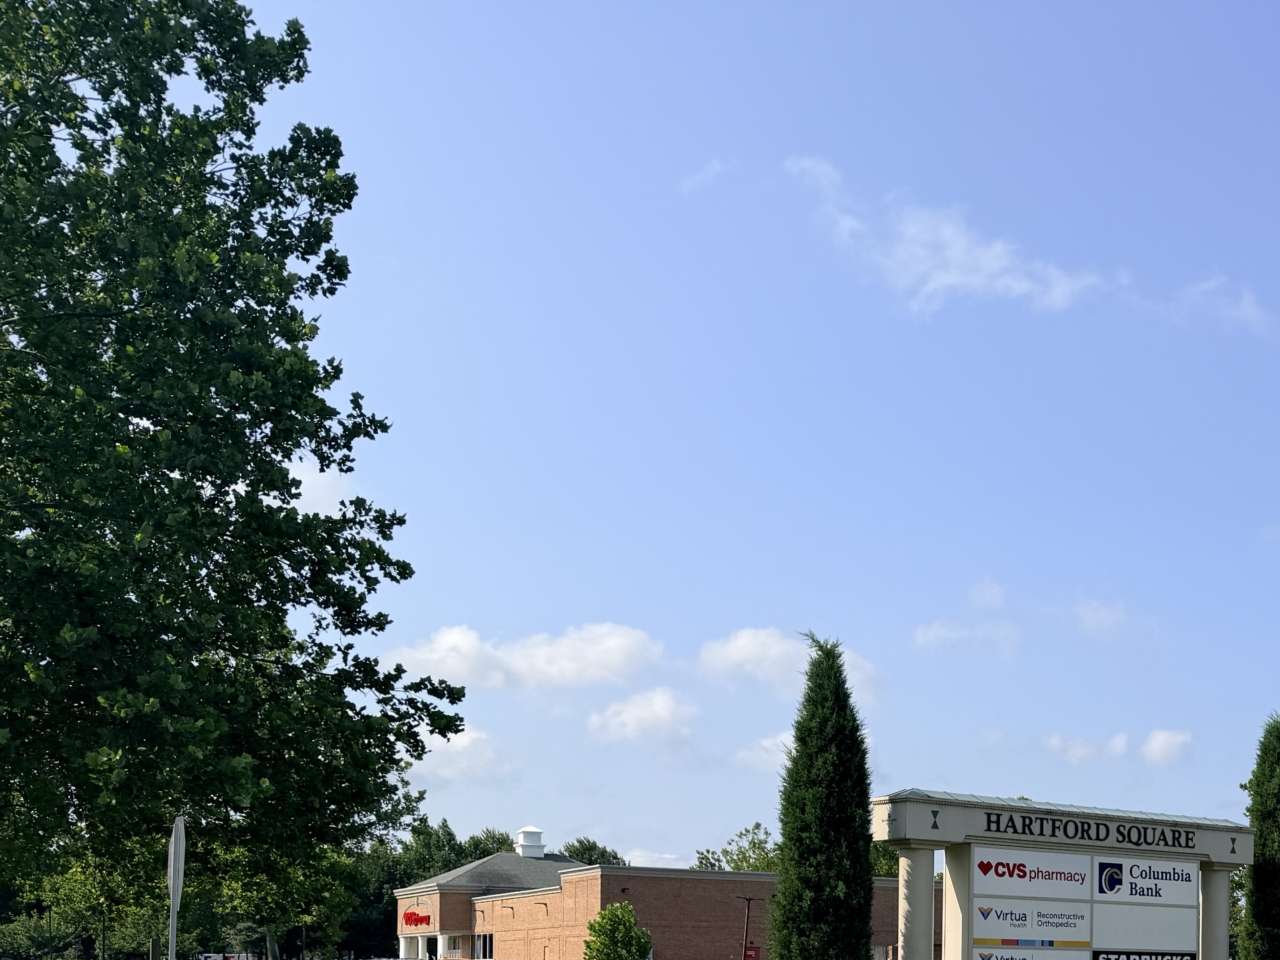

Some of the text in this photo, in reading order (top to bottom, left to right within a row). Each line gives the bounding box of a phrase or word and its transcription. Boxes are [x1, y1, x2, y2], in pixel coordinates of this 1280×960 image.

[984, 812, 1196, 849] HARTFORD SQUARE
[994, 861, 1086, 885] CVS pharmacy
[1129, 864, 1192, 882] Columbia
[1129, 882, 1162, 898] Bank
[995, 909, 1027, 922] Virtua
[1037, 911, 1085, 921] Reconstructive
[1037, 920, 1077, 930] Orthopedics
